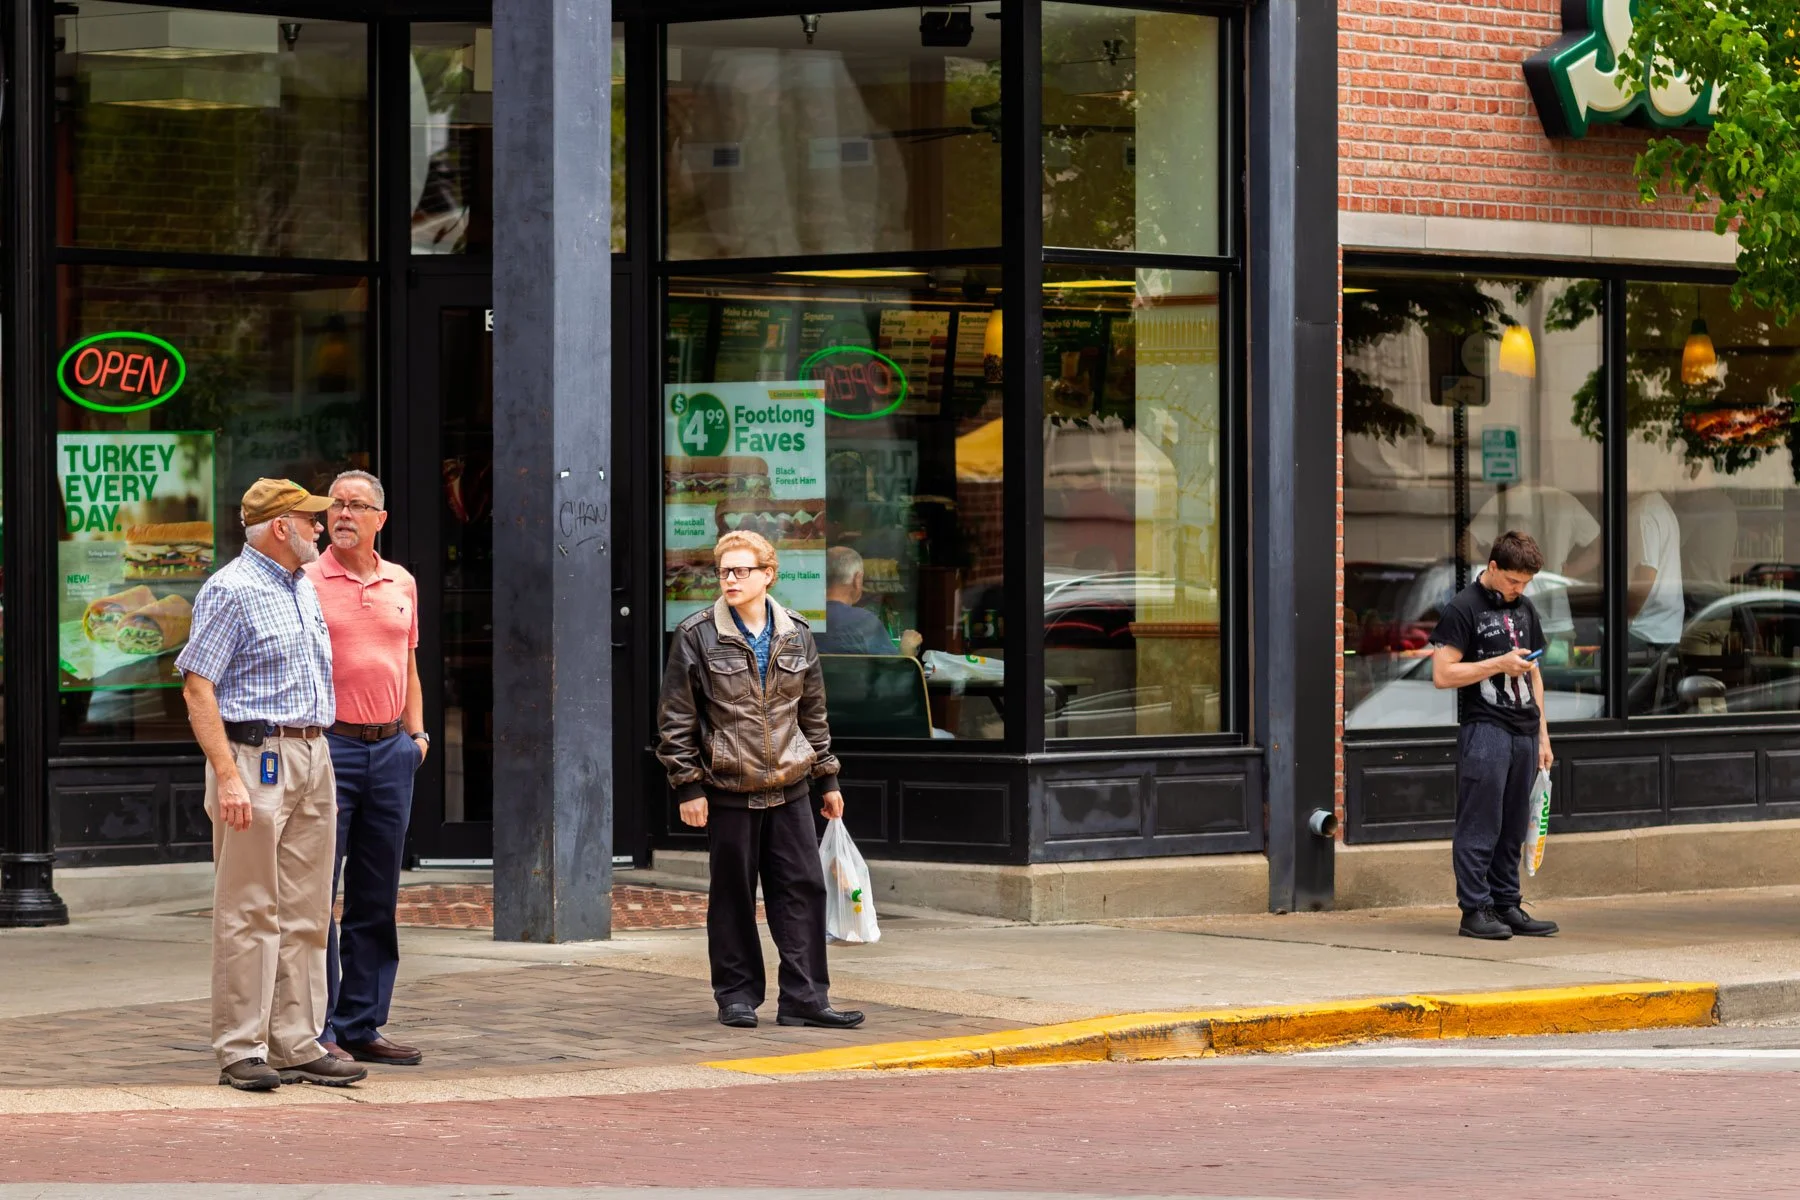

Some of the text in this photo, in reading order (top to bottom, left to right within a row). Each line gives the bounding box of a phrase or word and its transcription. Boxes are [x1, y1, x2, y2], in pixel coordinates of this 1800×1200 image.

[74, 347, 169, 396] OPEN
[734, 404, 815, 428] Footlong
[735, 427, 806, 452] Faves
[64, 444, 176, 473] TURKEY
[775, 467, 795, 475] Black
[65, 474, 159, 503] EVERY
[775, 477, 817, 485] Forest Ham
[66, 504, 123, 533] DAY.
[674, 517, 705, 526] Meatball
[674, 528, 705, 536] Marinara
[67, 574, 90, 584] NEW!
[778, 571, 820, 581] Spicy Italian
